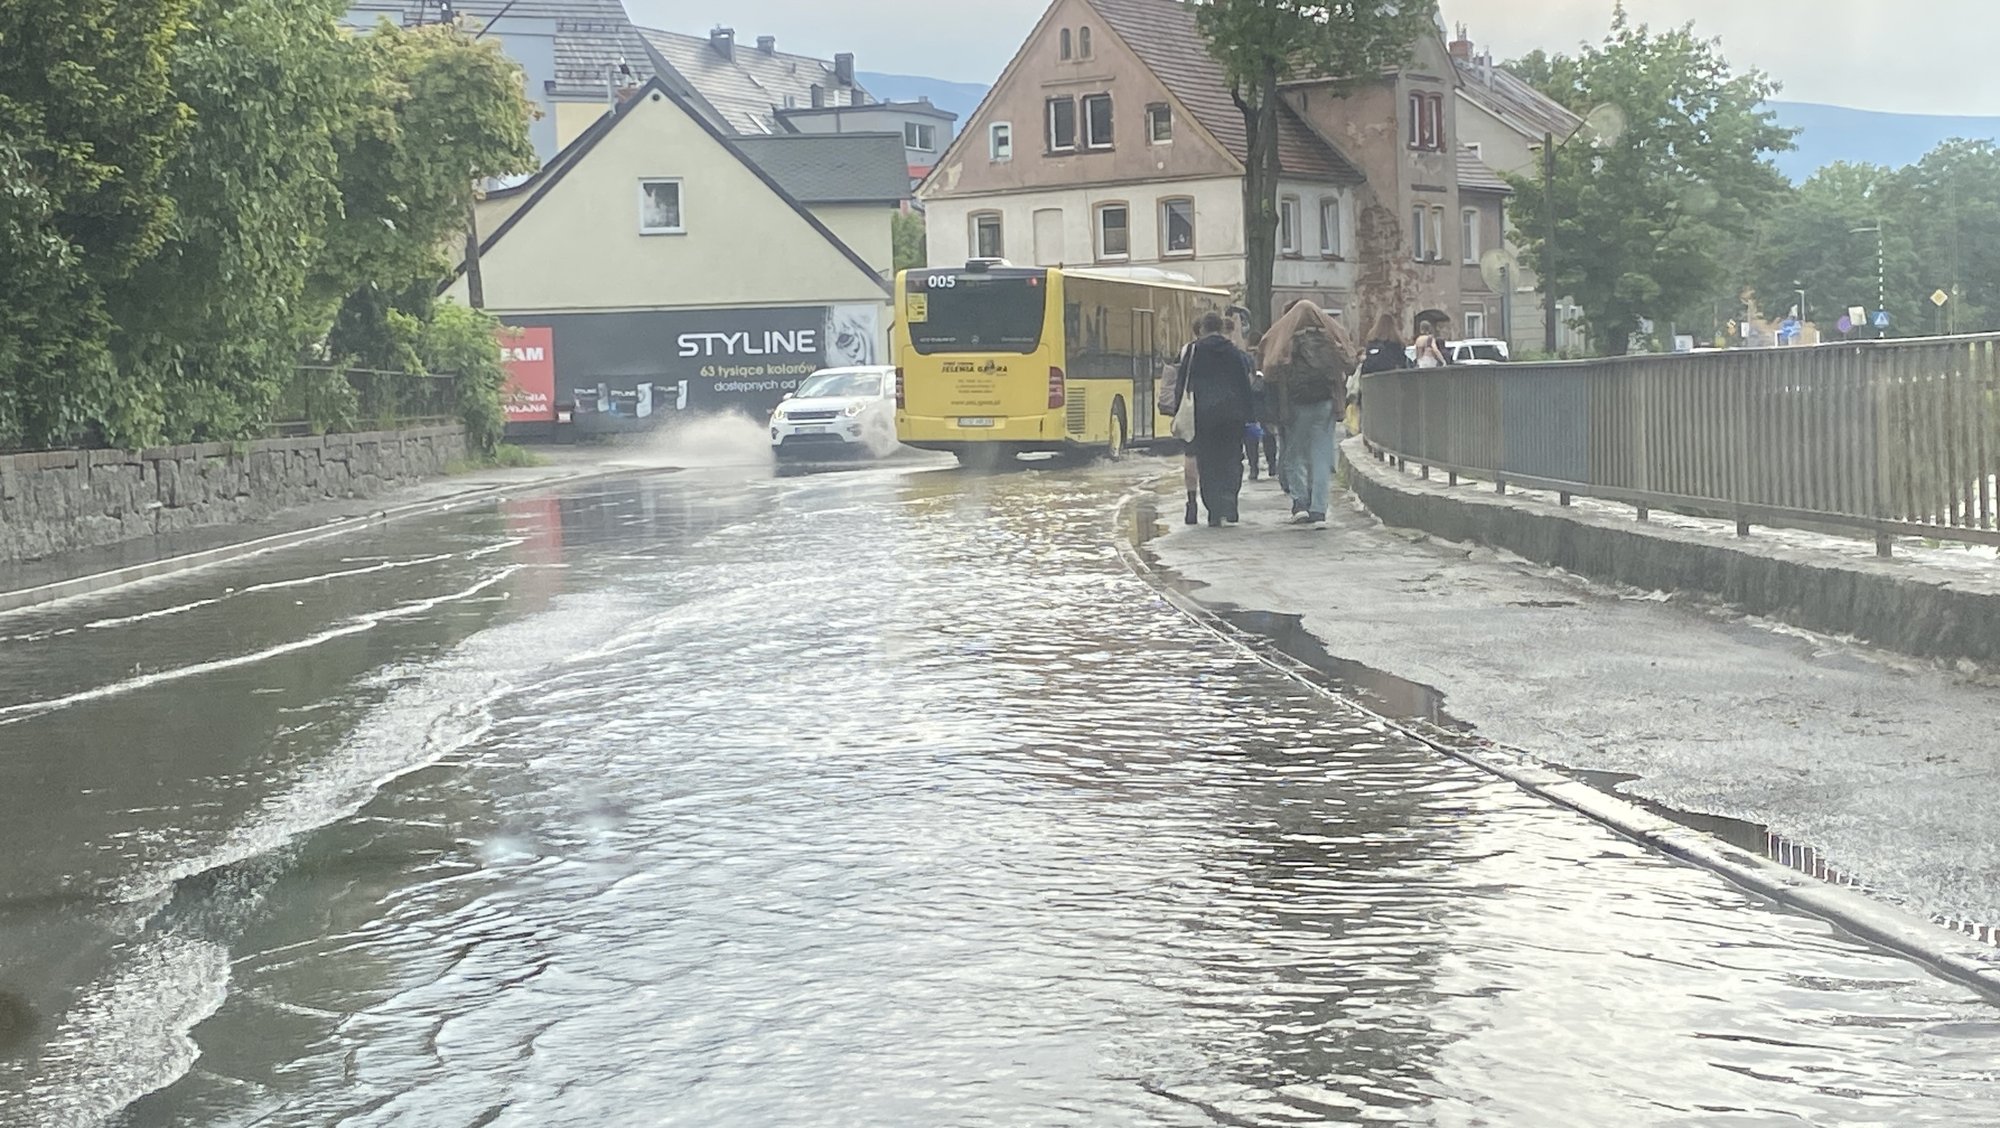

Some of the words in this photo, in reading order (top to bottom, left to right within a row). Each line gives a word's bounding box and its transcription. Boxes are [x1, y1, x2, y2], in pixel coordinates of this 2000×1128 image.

[927, 275, 956, 288] 005
[677, 329, 817, 357] STYLINE
[500, 347, 544, 361] EAM
[700, 365, 715, 377] 63
[718, 363, 764, 378] tysiące
[767, 361, 817, 375] kolorów
[713, 380, 779, 392] dostępnych
[780, 379, 796, 390] od
